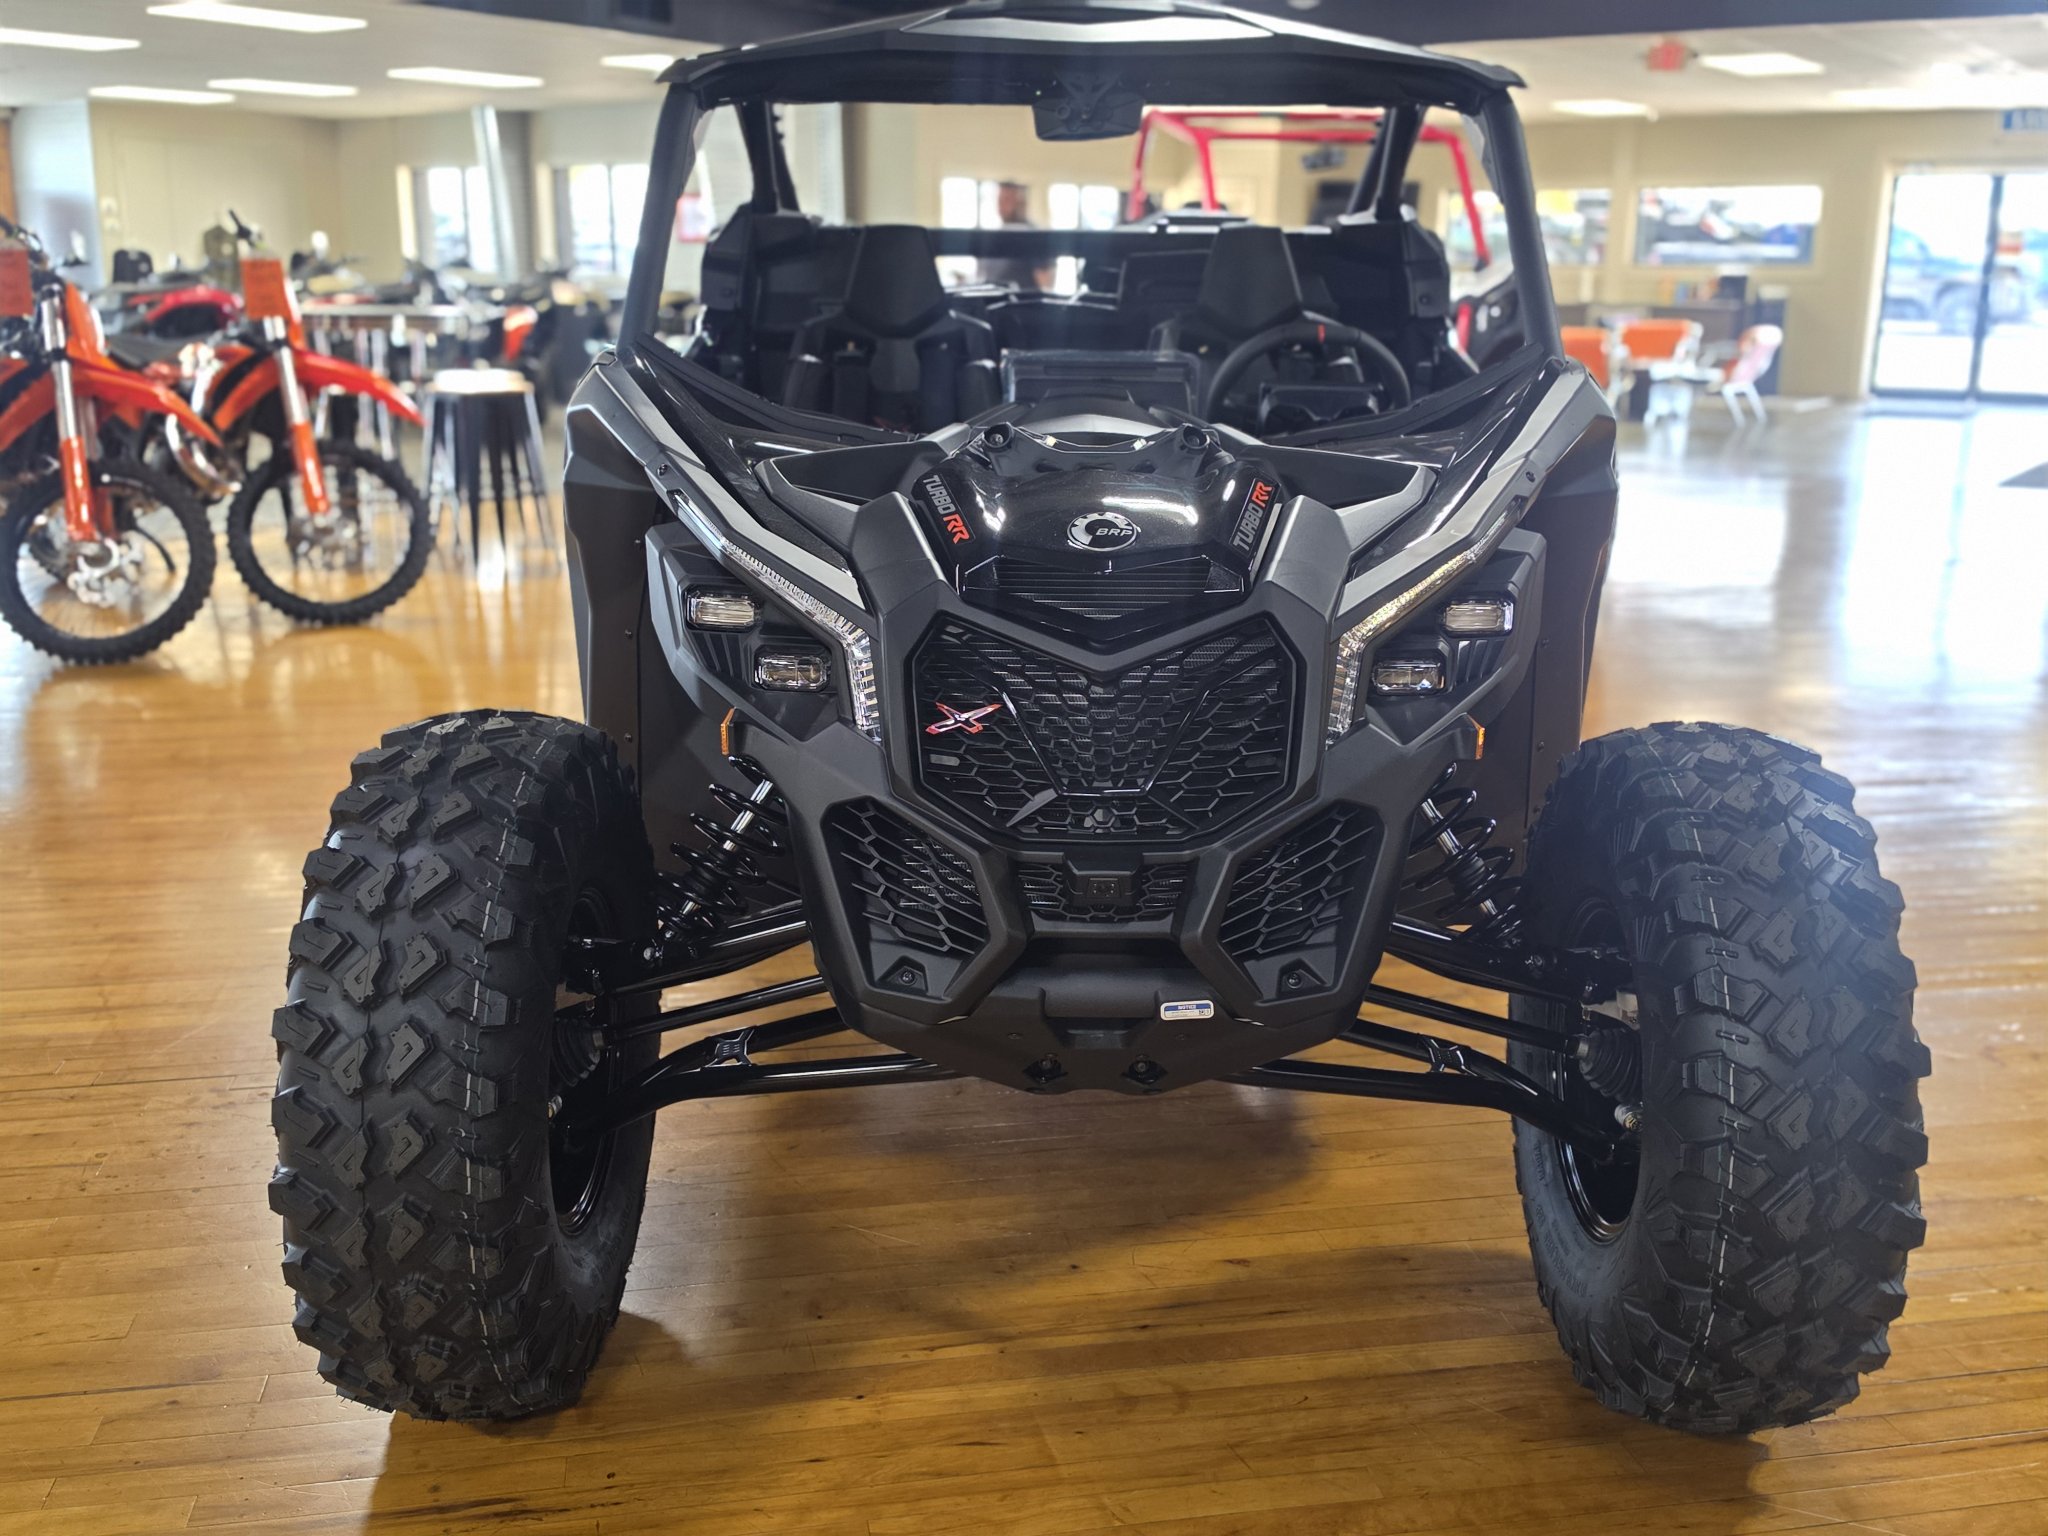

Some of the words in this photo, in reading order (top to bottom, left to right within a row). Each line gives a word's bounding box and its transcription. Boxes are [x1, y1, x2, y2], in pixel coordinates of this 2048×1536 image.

[923, 475, 956, 515] TURBO
[943, 513, 970, 545] RR
[1095, 527, 1133, 537] BRP
[1233, 502, 1264, 551] TURBO
[1252, 481, 1274, 508] RR
